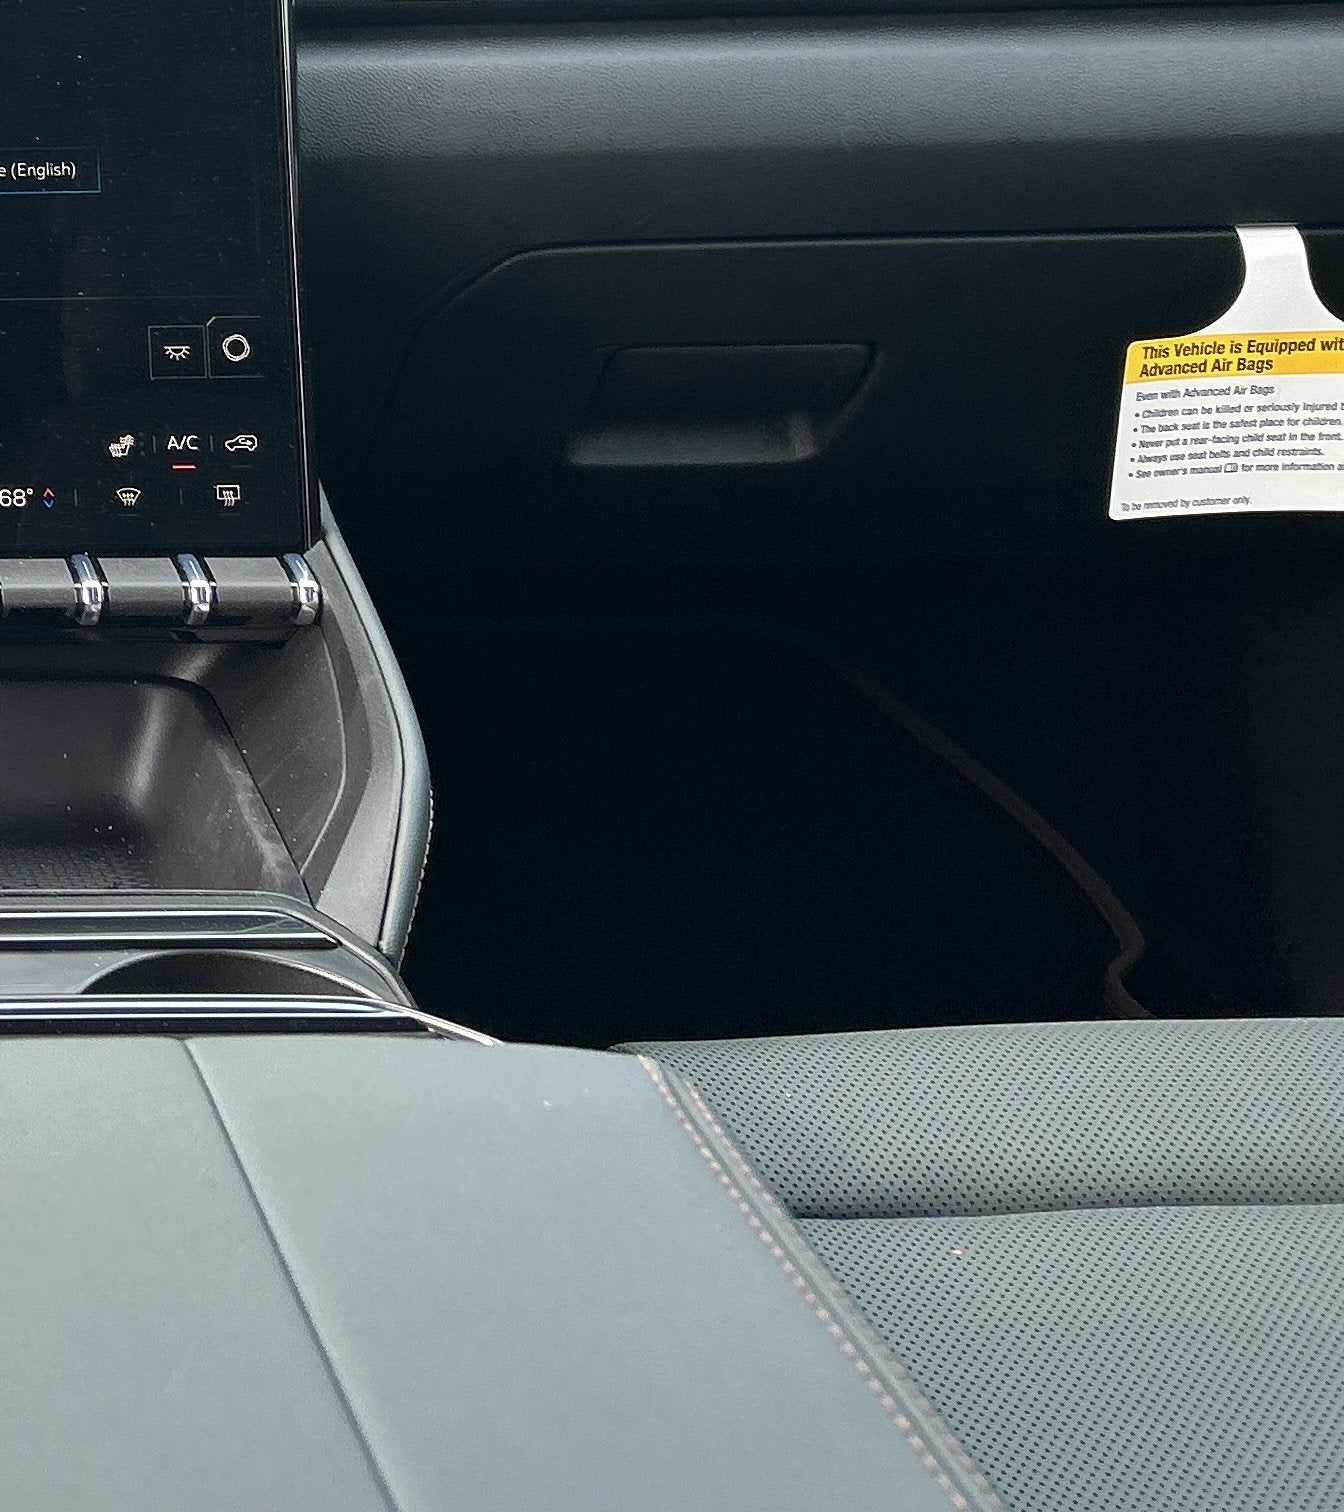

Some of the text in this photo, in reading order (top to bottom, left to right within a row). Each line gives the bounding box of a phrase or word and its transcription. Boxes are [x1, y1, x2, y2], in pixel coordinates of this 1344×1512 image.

[10, 161, 77, 181] (English)
[1142, 345, 1170, 360] This
[1174, 341, 1226, 357] Vehicle
[1230, 340, 1242, 354] is
[1247, 338, 1316, 355] Equipped
[1139, 357, 1274, 378] Advanced Air Bags
[1183, 386, 1231, 398] Advanced
[1233, 385, 1248, 395] Air
[1250, 385, 1275, 397] Bags
[1181, 408, 1199, 416] can
[1141, 424, 1156, 434] The
[1158, 422, 1179, 433] back
[1259, 418, 1285, 429] place
[167, 434, 200, 451] A/C
[1242, 433, 1265, 443] child
[1266, 432, 1287, 442] seat
[1187, 451, 1208, 460] seat
[1241, 463, 1254, 472] for
